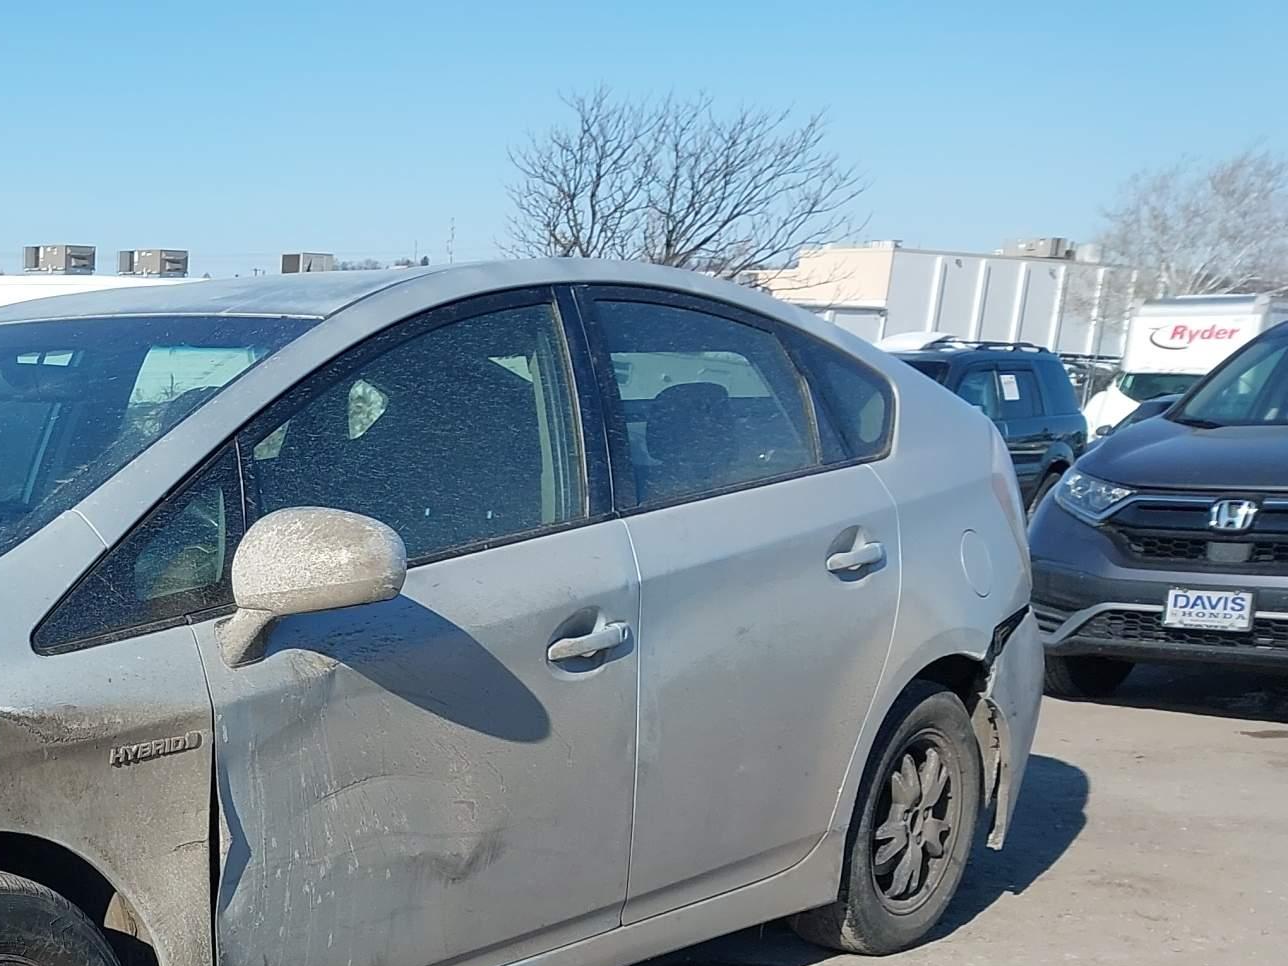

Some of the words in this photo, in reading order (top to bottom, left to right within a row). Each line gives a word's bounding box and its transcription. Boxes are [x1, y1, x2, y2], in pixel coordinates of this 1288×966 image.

[1170, 324, 1240, 344] Ryder
[1173, 593, 1245, 612] DAVIS
[1182, 610, 1246, 620] HONDA
[109, 736, 186, 765] HYBRID
